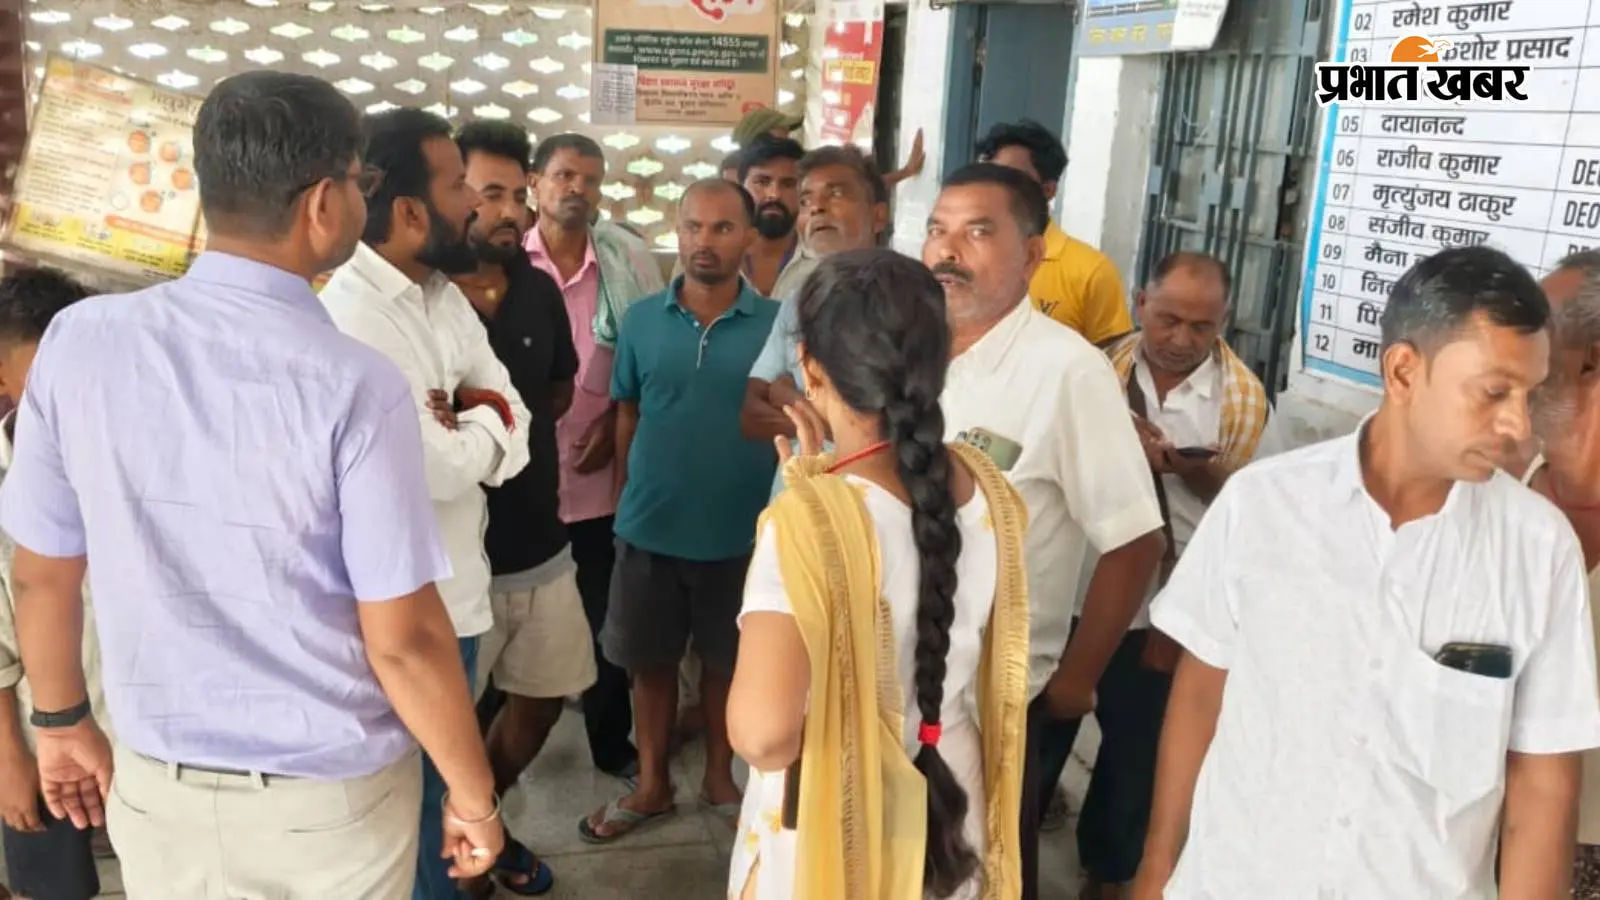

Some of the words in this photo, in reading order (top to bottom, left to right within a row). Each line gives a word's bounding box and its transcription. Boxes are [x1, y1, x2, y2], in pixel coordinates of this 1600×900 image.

[1354, 12, 1372, 31] 02
[1392, 2, 1441, 28] रमेश
[1447, 0, 1513, 30] कुमार
[1350, 47, 1368, 62] 03
[1506, 36, 1573, 62] प्रसाद
[1341, 115, 1360, 133] 05
[1381, 114, 1467, 136] दायानन्द
[1336, 149, 1355, 168] 06
[1376, 144, 1434, 171] राजीव
[1438, 151, 1502, 180] कुमार
[1572, 158, 1600, 187] DE
[1332, 183, 1350, 201] 07
[1372, 183, 1453, 212] मृत्युंजय
[1458, 191, 1518, 221] ठाकुर
[1563, 200, 1600, 229] DEO
[1328, 214, 1346, 231] 08
[1368, 213, 1425, 240] संजीव
[1323, 244, 1342, 260] 09
[1364, 240, 1408, 267] मैना
[1321, 272, 1336, 290] 10
[1320, 303, 1332, 320] 11
[1314, 333, 1329, 352] 12
